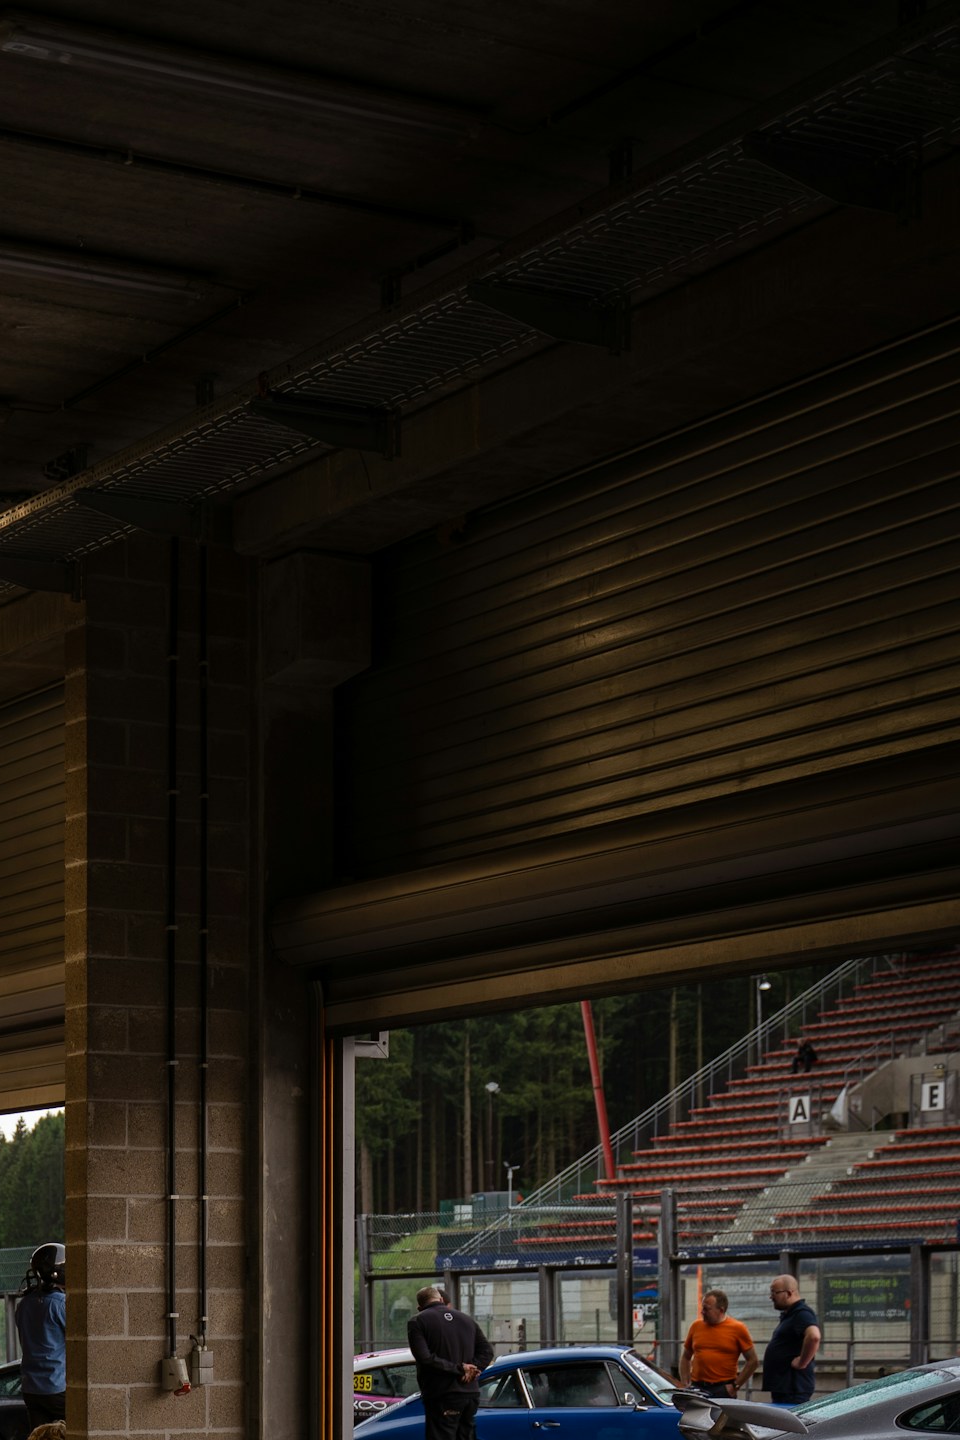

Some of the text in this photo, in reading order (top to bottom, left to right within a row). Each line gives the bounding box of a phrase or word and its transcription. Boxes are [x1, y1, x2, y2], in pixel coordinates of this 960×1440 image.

[929, 1085, 939, 1108] E
[793, 1098, 807, 1121] A
[353, 1376, 371, 1389] 395
